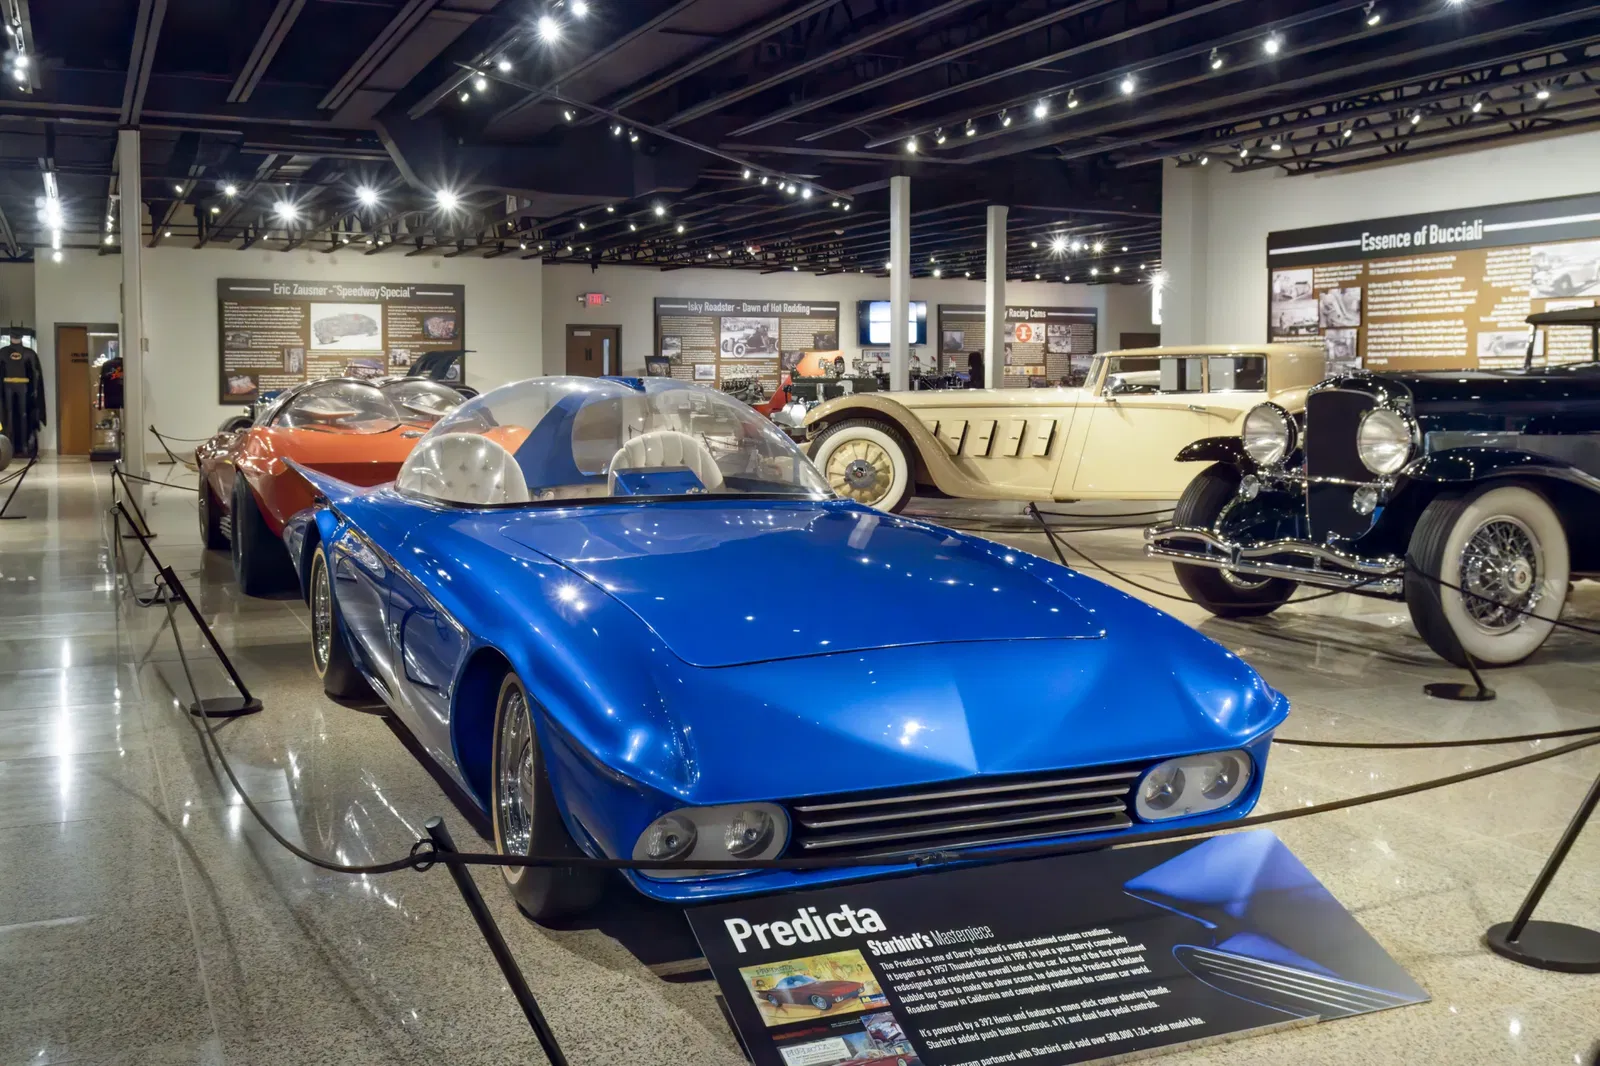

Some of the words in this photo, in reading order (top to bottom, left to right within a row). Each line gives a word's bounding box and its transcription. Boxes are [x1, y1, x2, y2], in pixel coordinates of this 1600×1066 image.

[1361, 232, 1411, 251] Essence
[1413, 225, 1428, 246] of
[1429, 219, 1483, 245] Bucciali
[273, 283, 291, 295] Eric
[293, 283, 327, 296] Zausner
[688, 302, 703, 313] Isky
[704, 302, 735, 312] Roadster
[743, 303, 761, 312] Dawn
[762, 303, 770, 312] of
[771, 303, 782, 312] Hot
[783, 303, 811, 315] Rodding
[1009, 308, 1029, 320] Racing
[1030, 308, 1046, 318] Cams
[724, 904, 887, 953] Predicta
[866, 932, 934, 957] Starbird's
[931, 925, 994, 948] Masterpiece
[880, 962, 895, 970] The
[894, 958, 924, 968] Predicta
[945, 952, 953, 960] of
[952, 948, 976, 959] Darryl
[974, 944, 1007, 955] Starbird's
[1007, 941, 1025, 950] most
[1024, 935, 1058, 947] acclaimed
[1057, 933, 1082, 942] custom
[892, 971, 916, 980] began
[931, 964, 948, 974] 1957
[947, 957, 991, 971] Thunderbird
[990, 955, 1004, 964] and
[1002, 954, 1012, 962] in
[1029, 950, 1038, 958] in
[1036, 948, 1052, 958] just
[1071, 940, 1094, 951] Darryl
[1093, 935, 1128, 947] completely
[893, 978, 933, 992] redesigned
[933, 976, 948, 985] and
[947, 971, 976, 983] restyled
[974, 970, 988, 978] the
[987, 965, 1012, 976] overall
[1009, 963, 1027, 972] look
[1026, 961, 1034, 970] of
[1068, 955, 1081, 963] one
[1081, 952, 1089, 961] of
[1087, 951, 1100, 959] the
[1098, 949, 1115, 957] first
[1113, 943, 1147, 957] prominent
[899, 992, 925, 1003] bubble
[924, 991, 937, 999] top
[938, 988, 954, 997] cars
[962, 983, 982, 993] make
[981, 981, 994, 989] the
[994, 979, 1013, 987] show
[1034, 972, 1046, 980] he
[1045, 966, 1073, 978] debuted
[1071, 966, 1084, 974] the
[1082, 961, 1112, 972] Predicta
[1110, 959, 1119, 967] at
[1117, 954, 1145, 966] Oakland
[905, 1003, 938, 1014] Roadster
[938, 1000, 959, 1009] Show
[958, 997, 968, 1005] in
[966, 992, 1001, 1004] California
[1000, 988, 1015, 998] and
[1014, 983, 1052, 996] completely
[1051, 977, 1083, 989] redefined
[1081, 976, 1095, 984] the
[1094, 972, 1119, 982] custom
[919, 1029, 932, 1037] It's
[932, 1022, 964, 1037] powered
[962, 1021, 974, 1031] by
[978, 1017, 994, 1027] 392
[992, 1013, 1013, 1024] Hemi
[1012, 1011, 1027, 1021] and
[1025, 1007, 1056, 1018] features
[1060, 1003, 1081, 1012] mono
[1080, 998, 1098, 1008] stick
[1097, 996, 1119, 1005] center
[1119, 991, 1148, 1001] steering
[926, 1036, 957, 1049] Starbird
[957, 1032, 980, 1044] added
[980, 1029, 999, 1041] push
[997, 1026, 1022, 1036] button
[1068, 1013, 1083, 1023] and
[1082, 1010, 1099, 1021] dual
[1096, 1008, 1112, 1018] foot
[1111, 1004, 1132, 1017] pedal
[980, 1051, 1016, 1066] partnered
[1015, 1049, 1033, 1059] with
[1031, 1043, 1062, 1056] Starbird
[1061, 1040, 1076, 1051] and
[1075, 1037, 1092, 1048] sold
[1090, 1036, 1107, 1045] over
[1105, 1029, 1134, 1042] 500,000
[1168, 1018, 1191, 1030] model
